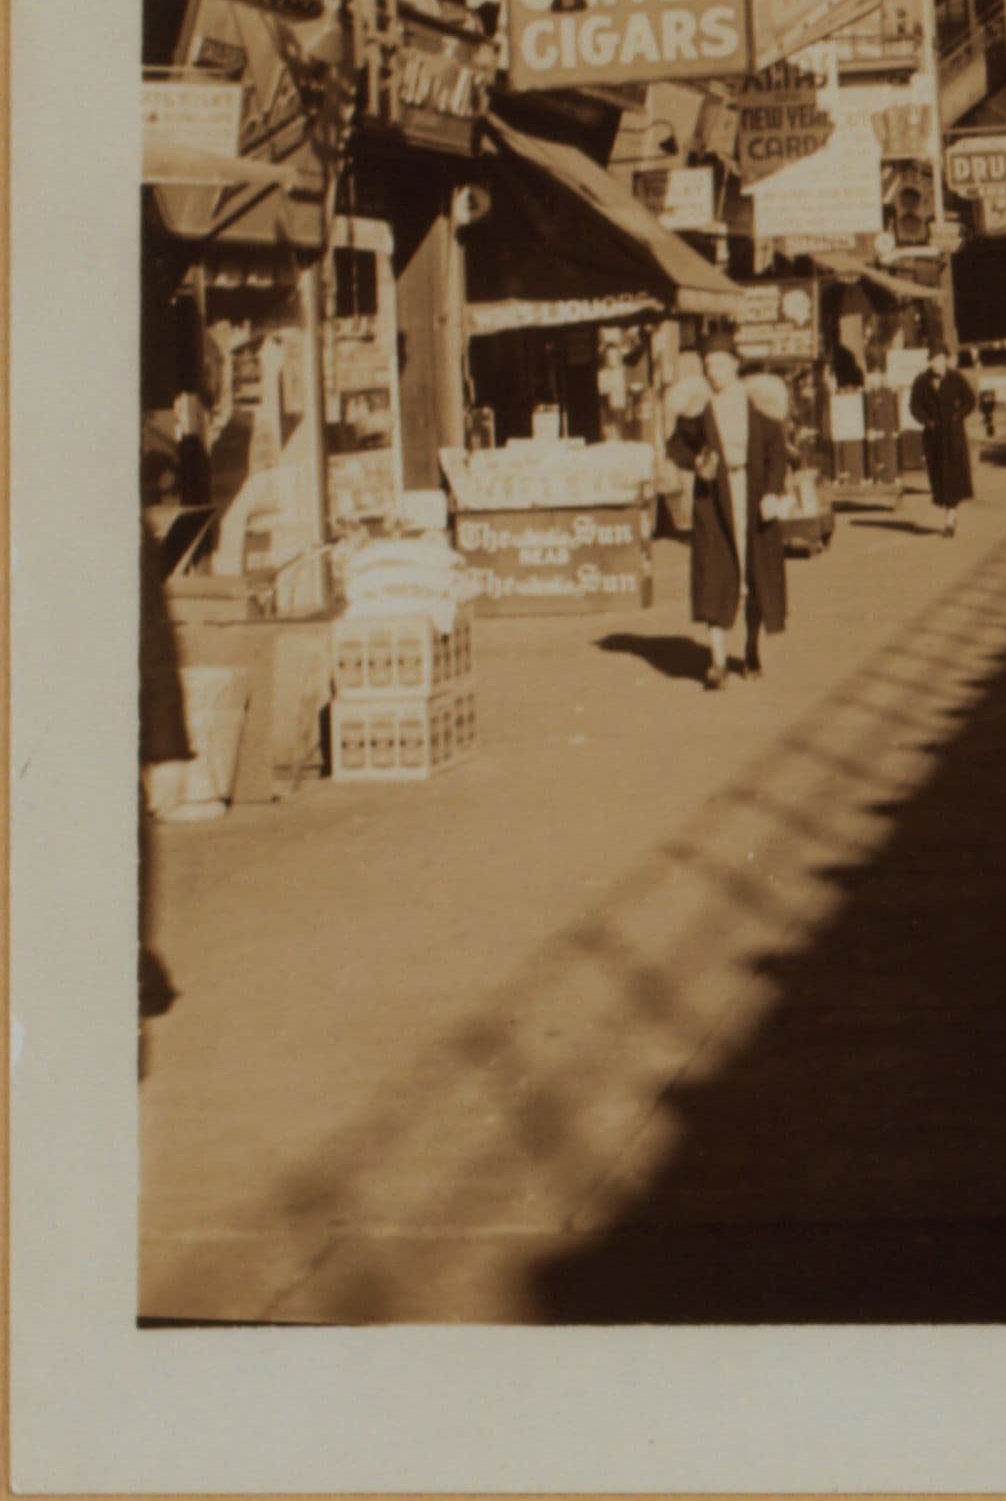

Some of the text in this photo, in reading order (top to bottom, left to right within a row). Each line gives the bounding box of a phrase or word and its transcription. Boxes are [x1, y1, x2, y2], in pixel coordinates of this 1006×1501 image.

[521, 6, 740, 71] CIGARS
[748, 133, 829, 160] CARD
[458, 515, 633, 553] The Sun
[576, 563, 637, 593] Sun
